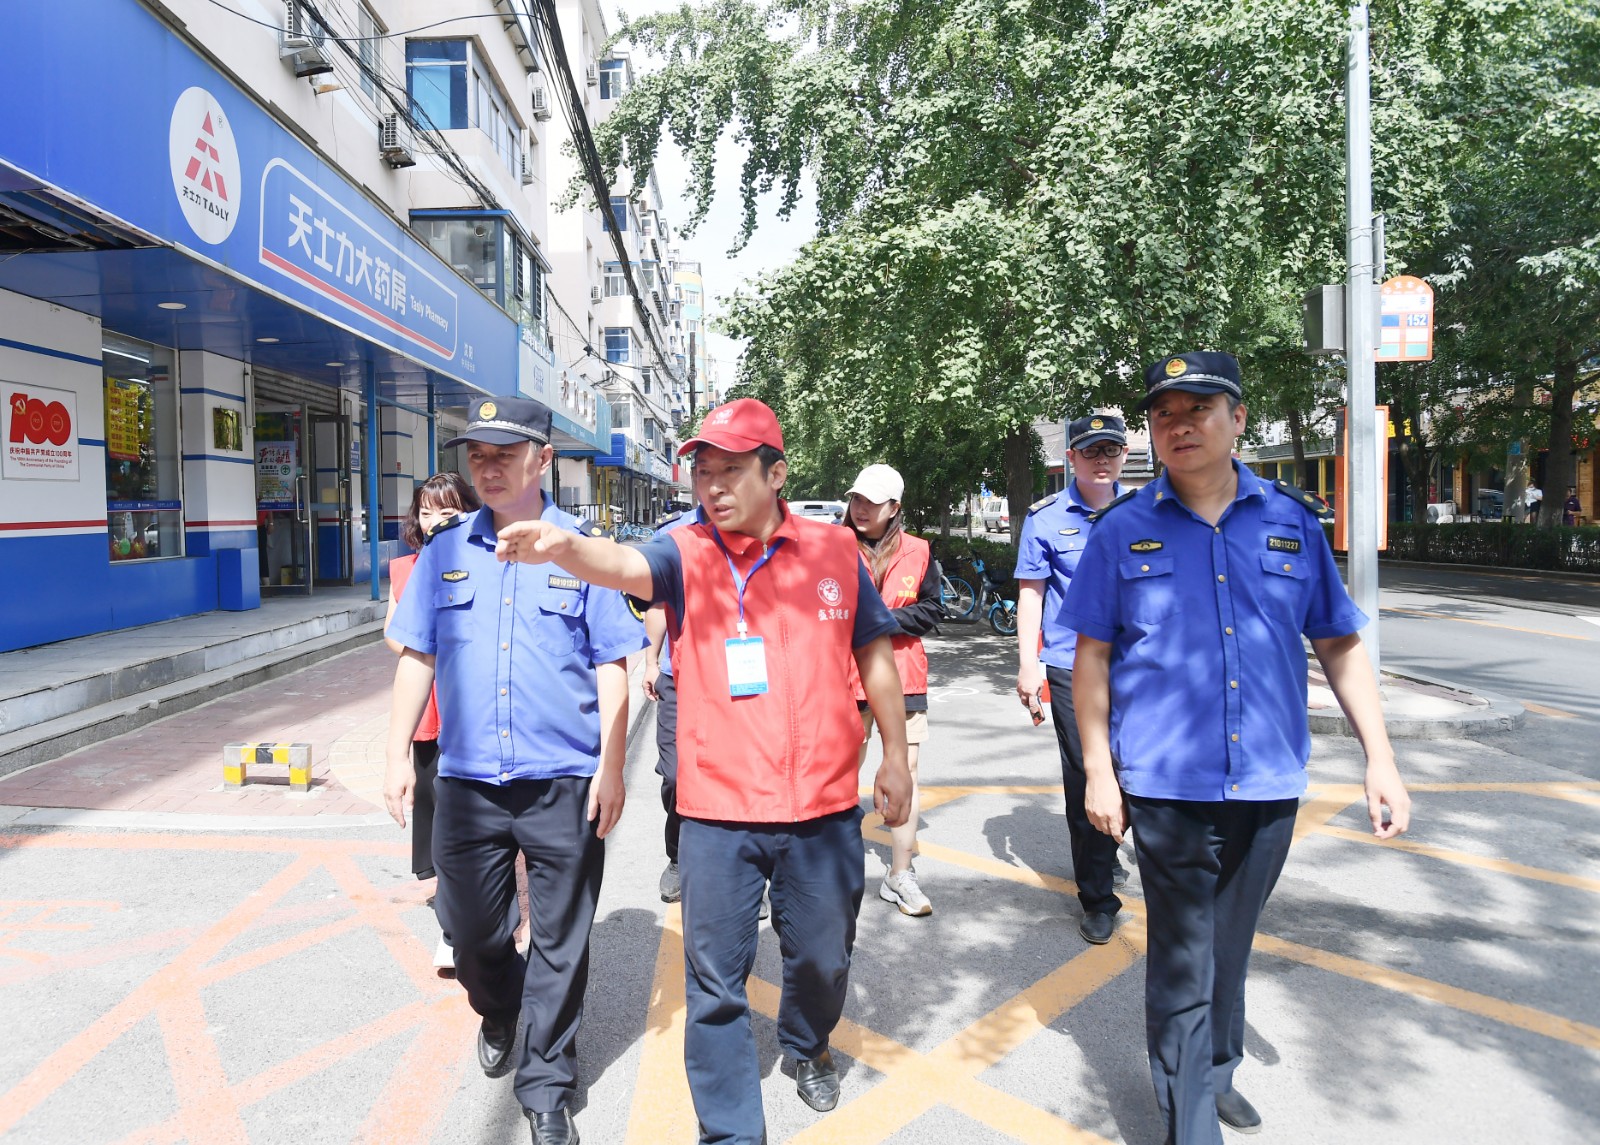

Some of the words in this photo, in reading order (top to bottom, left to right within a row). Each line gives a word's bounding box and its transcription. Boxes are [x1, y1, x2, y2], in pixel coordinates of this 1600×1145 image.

[183, 186, 201, 206] 天士力
[203, 197, 230, 222] TASLY
[288, 193, 407, 316] 天士力大药房
[410, 294, 424, 318] Tasly
[1407, 313, 1427, 327] 152
[10, 392, 71, 447] 100
[1269, 538, 1299, 550] 21011227
